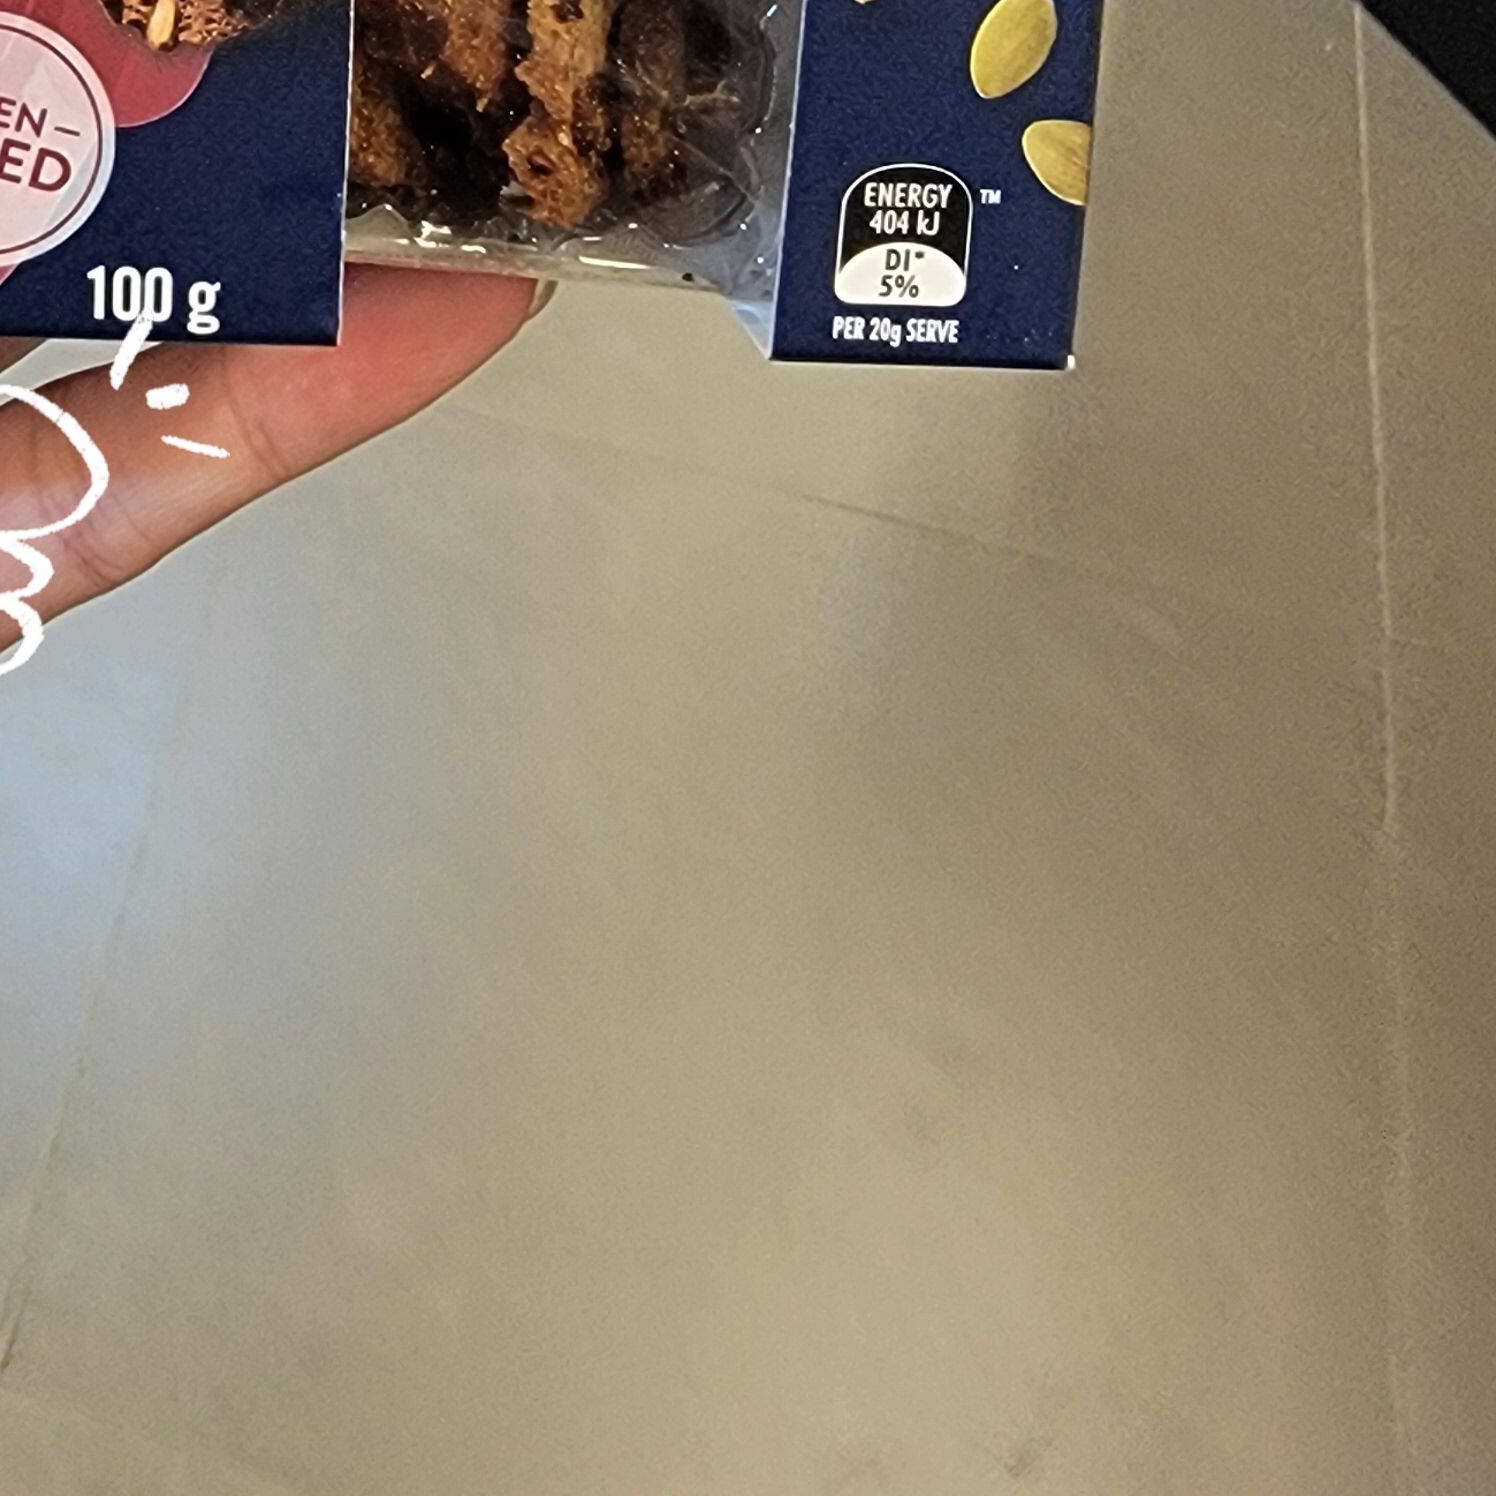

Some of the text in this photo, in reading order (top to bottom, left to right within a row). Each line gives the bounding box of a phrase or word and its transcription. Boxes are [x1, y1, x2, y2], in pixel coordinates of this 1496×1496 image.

[863, 182, 953, 208] ENERGY
[869, 209, 940, 236] 404 kJ
[86, 265, 221, 334] 100 g
[878, 274, 919, 298] 5%
[832, 316, 960, 347] PER 20g SERVE
